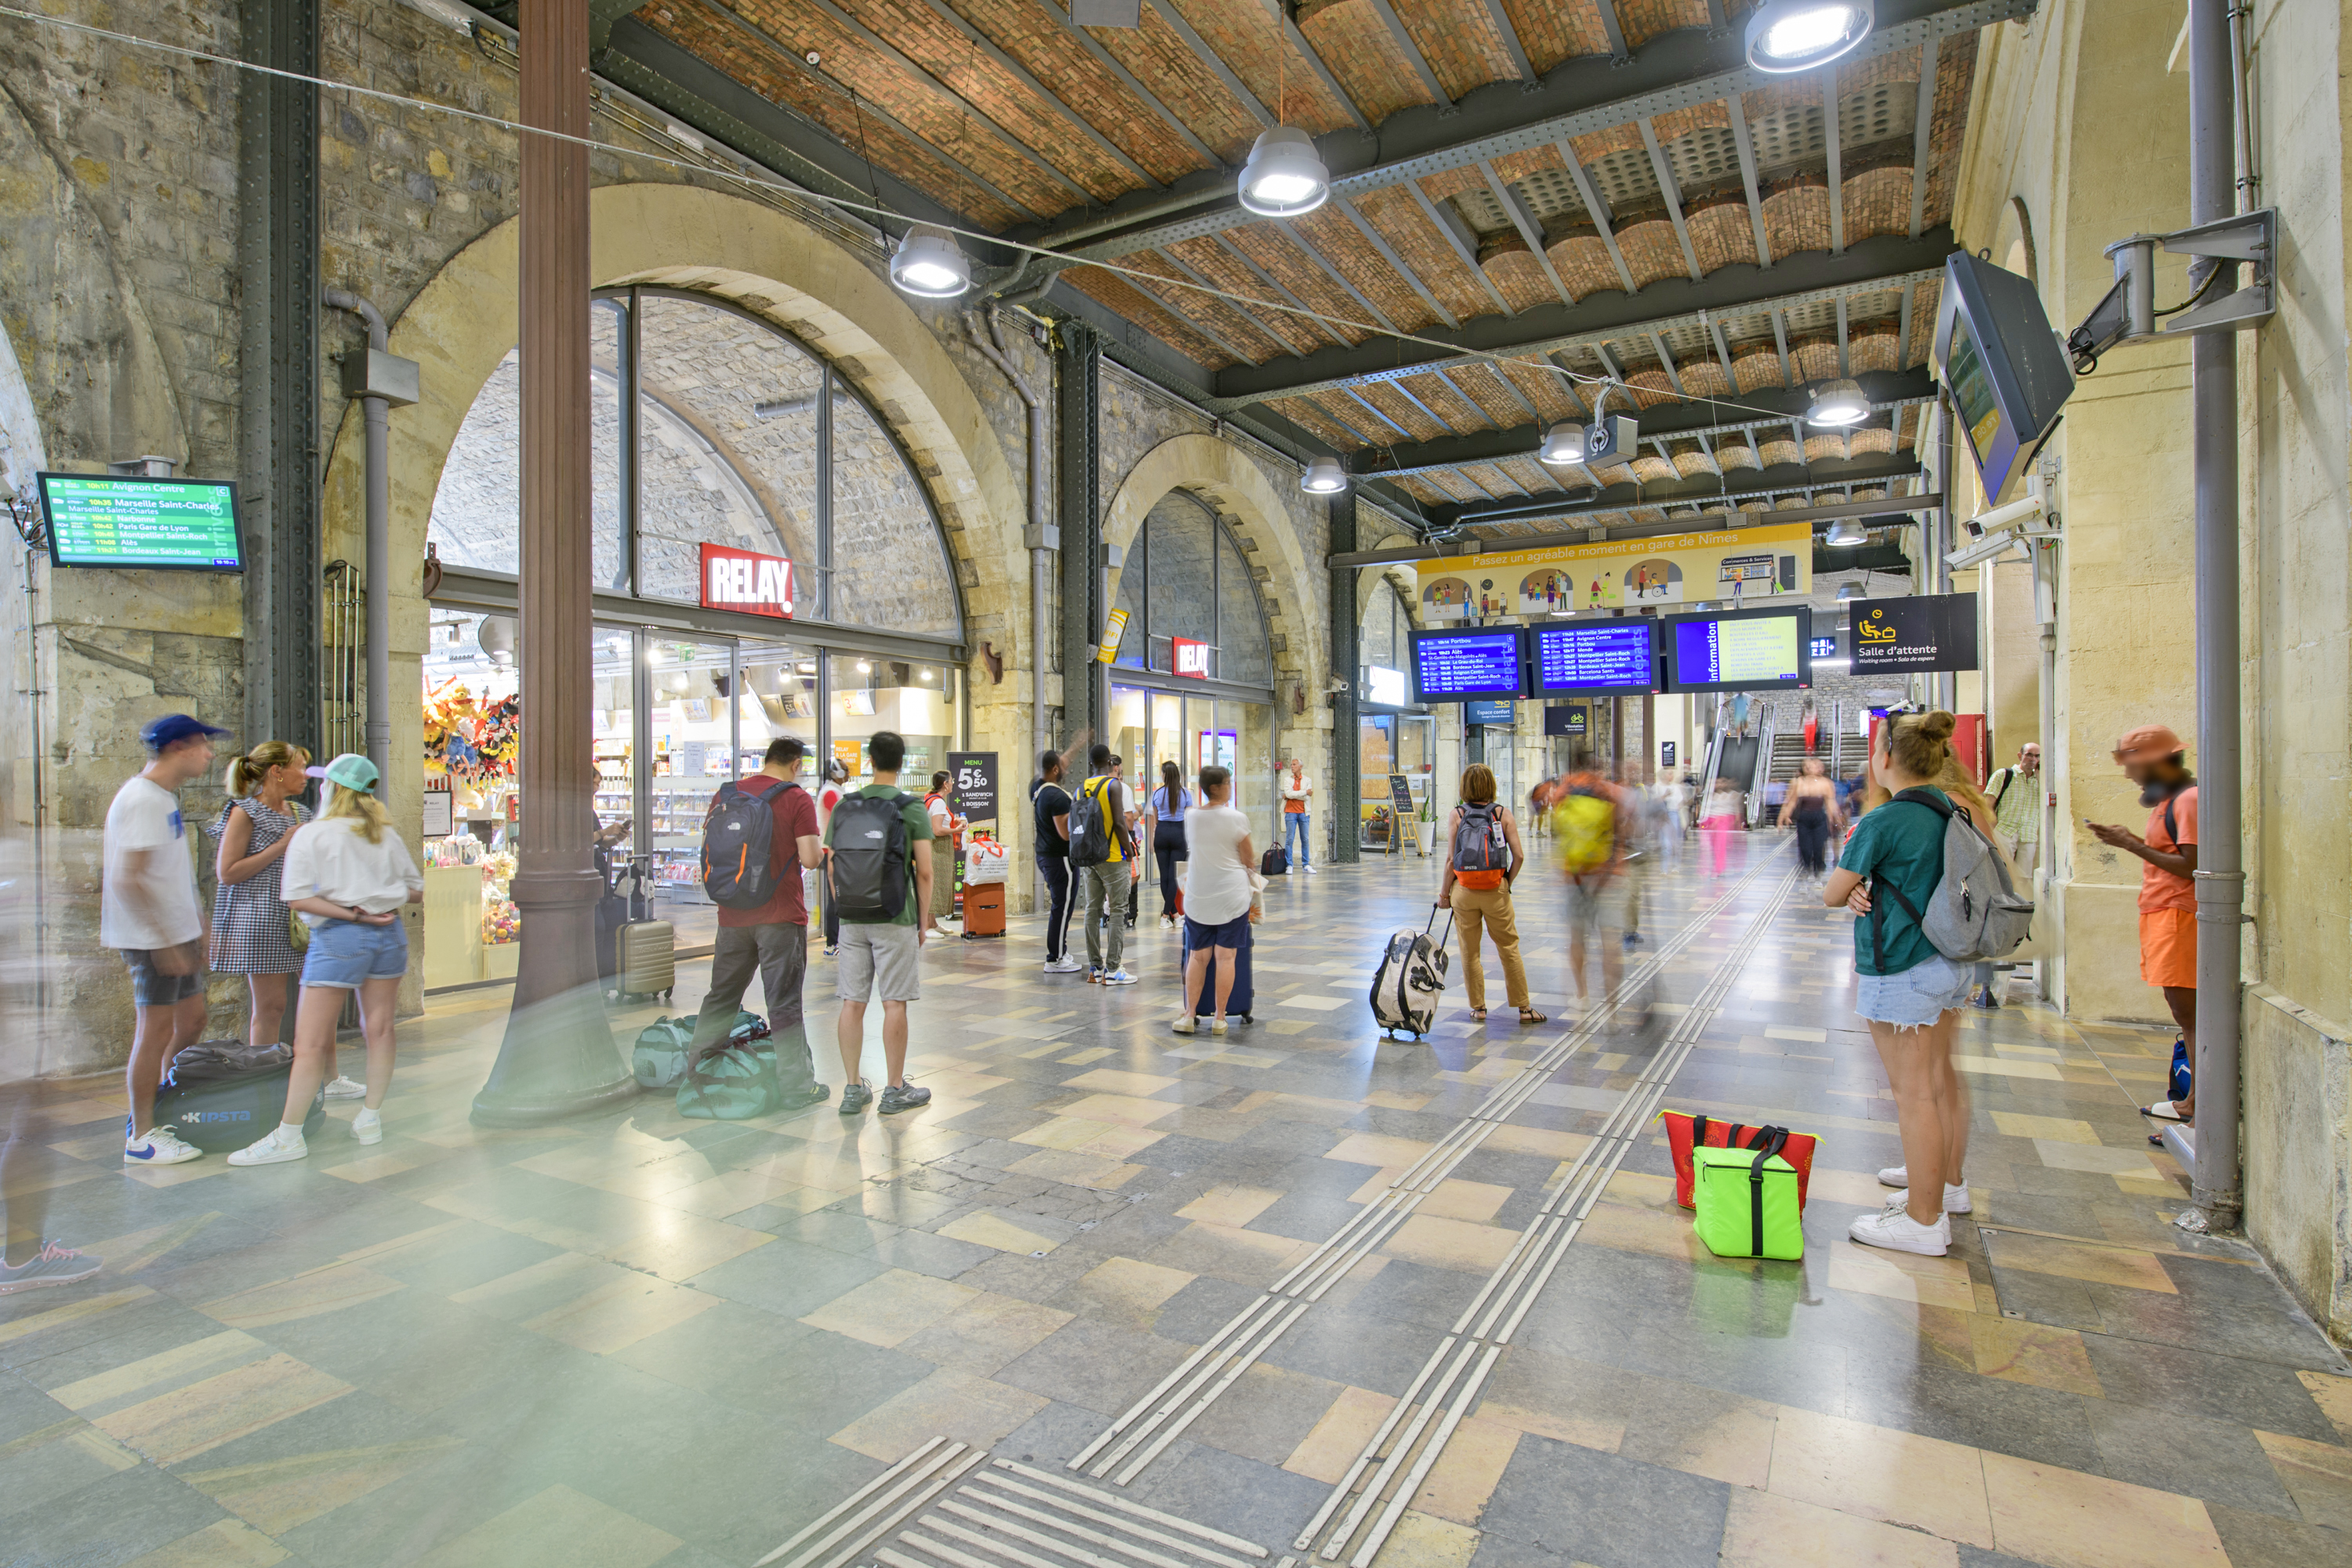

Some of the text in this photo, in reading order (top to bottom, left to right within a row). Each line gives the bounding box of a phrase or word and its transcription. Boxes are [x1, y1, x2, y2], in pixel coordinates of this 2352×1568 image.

[112, 482, 151, 492] Avignon
[159, 501, 219, 510] Saint-Charles
[205, 487, 228, 557] arrivées
[1473, 532, 1737, 566] Passez un agréable moment en gare de Nîmes
[1501, 643, 1515, 690] départs
[1632, 629, 1646, 678] départs
[1707, 622, 1718, 681] information
[1859, 645, 1937, 656] Salle d'attente
